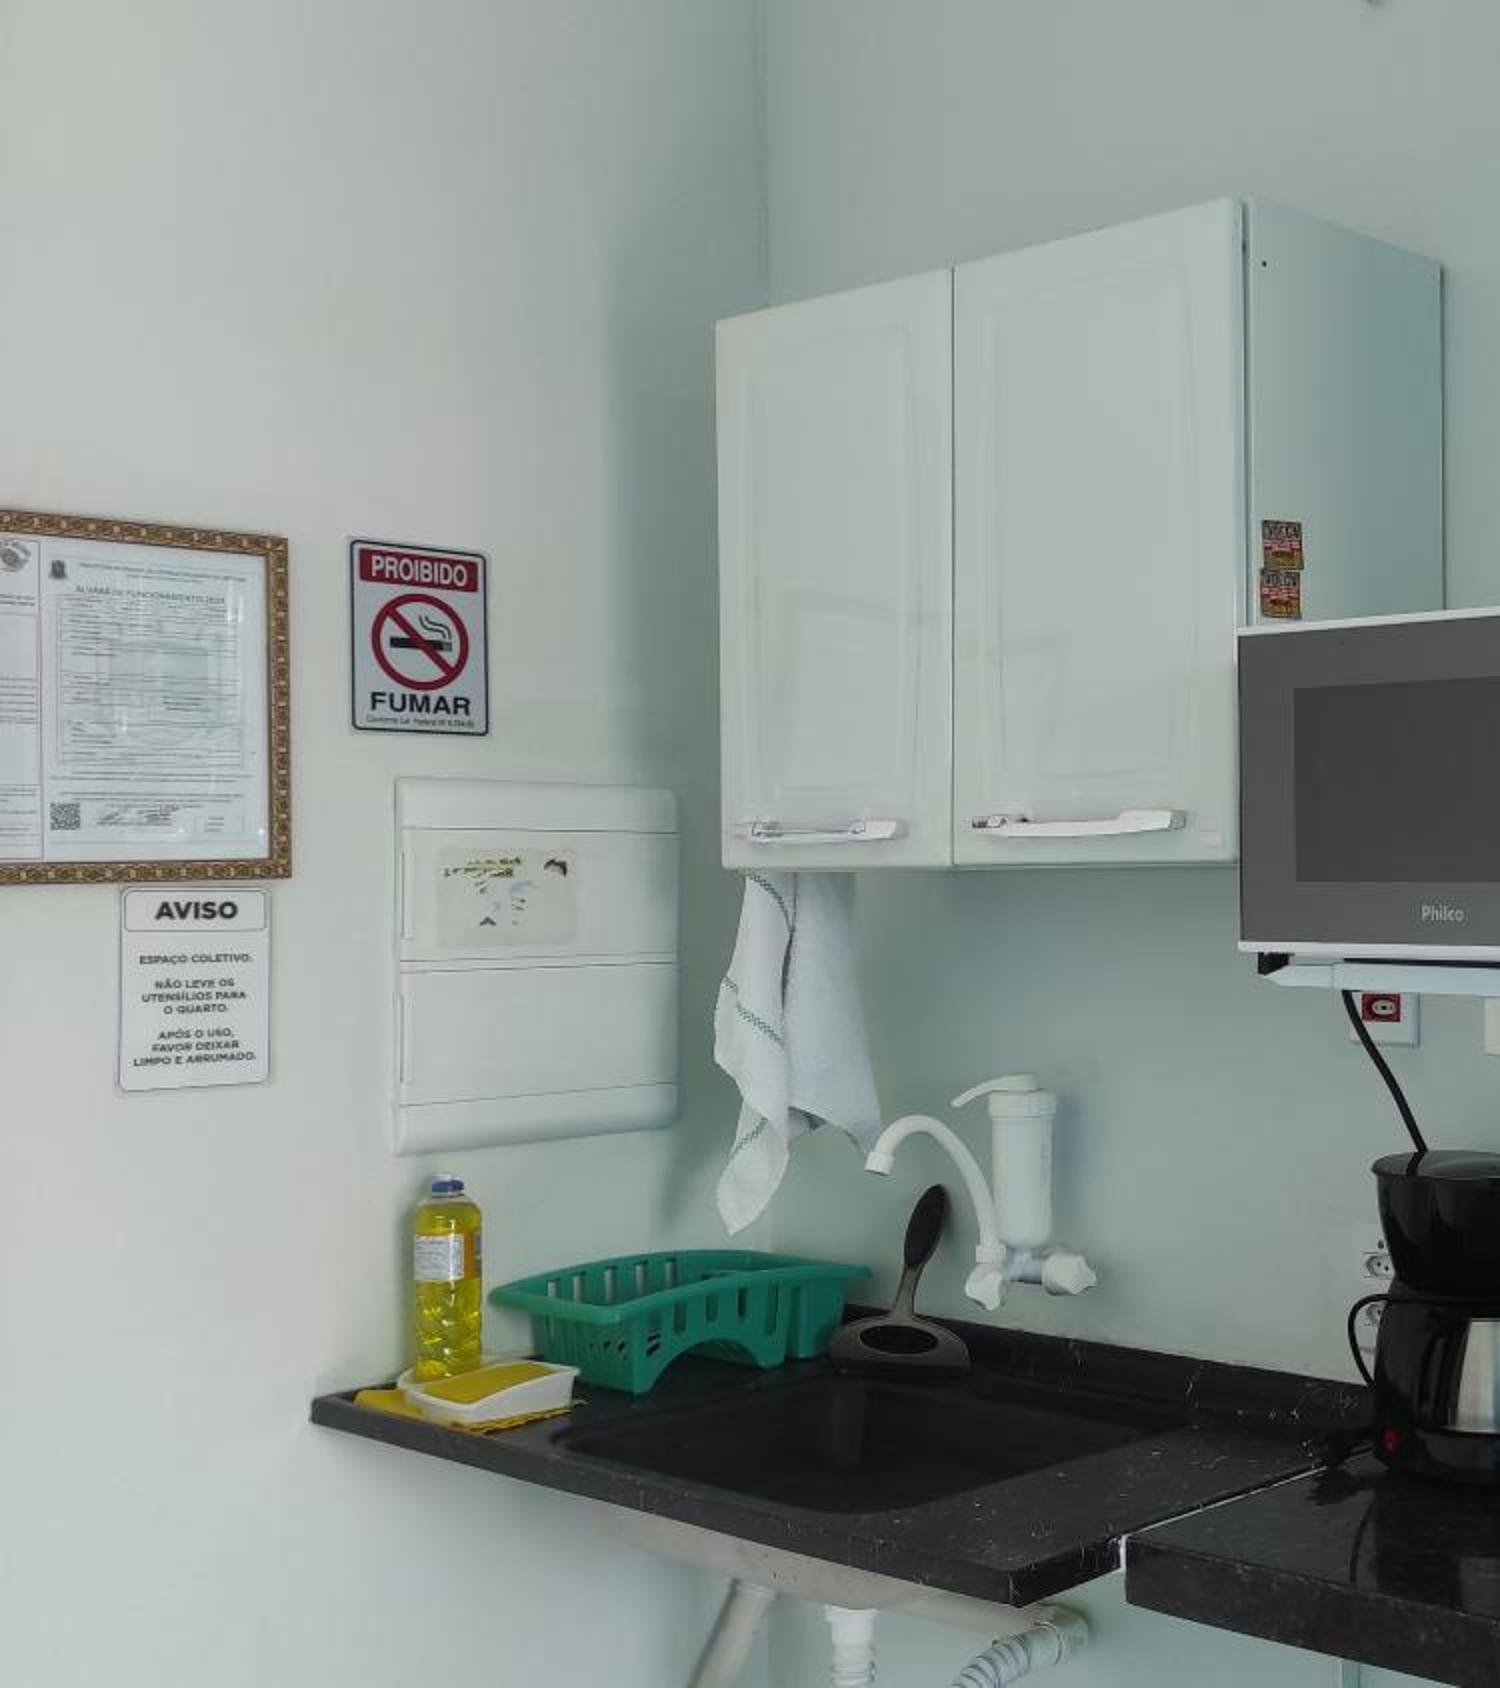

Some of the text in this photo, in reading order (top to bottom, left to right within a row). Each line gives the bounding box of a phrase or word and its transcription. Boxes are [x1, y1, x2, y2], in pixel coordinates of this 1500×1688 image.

[371, 555, 468, 587] PROIBIDO
[370, 692, 471, 716] FUMAR
[155, 901, 239, 920] AVISO
[1421, 904, 1465, 922] Philco
[139, 954, 188, 966] ESPAÇO
[155, 978, 235, 989] NÃO LEVE OS
[142, 990, 246, 1003] UTENSÍLIOS PARA
[163, 1005, 173, 1015] O
[158, 1028, 191, 1040] APÓS
[195, 1028, 204, 1039] O
[152, 1039, 239, 1053] FAVOR DEIXAR
[133, 1056, 172, 1067] LIMPO
[175, 1054, 183, 1065] E
